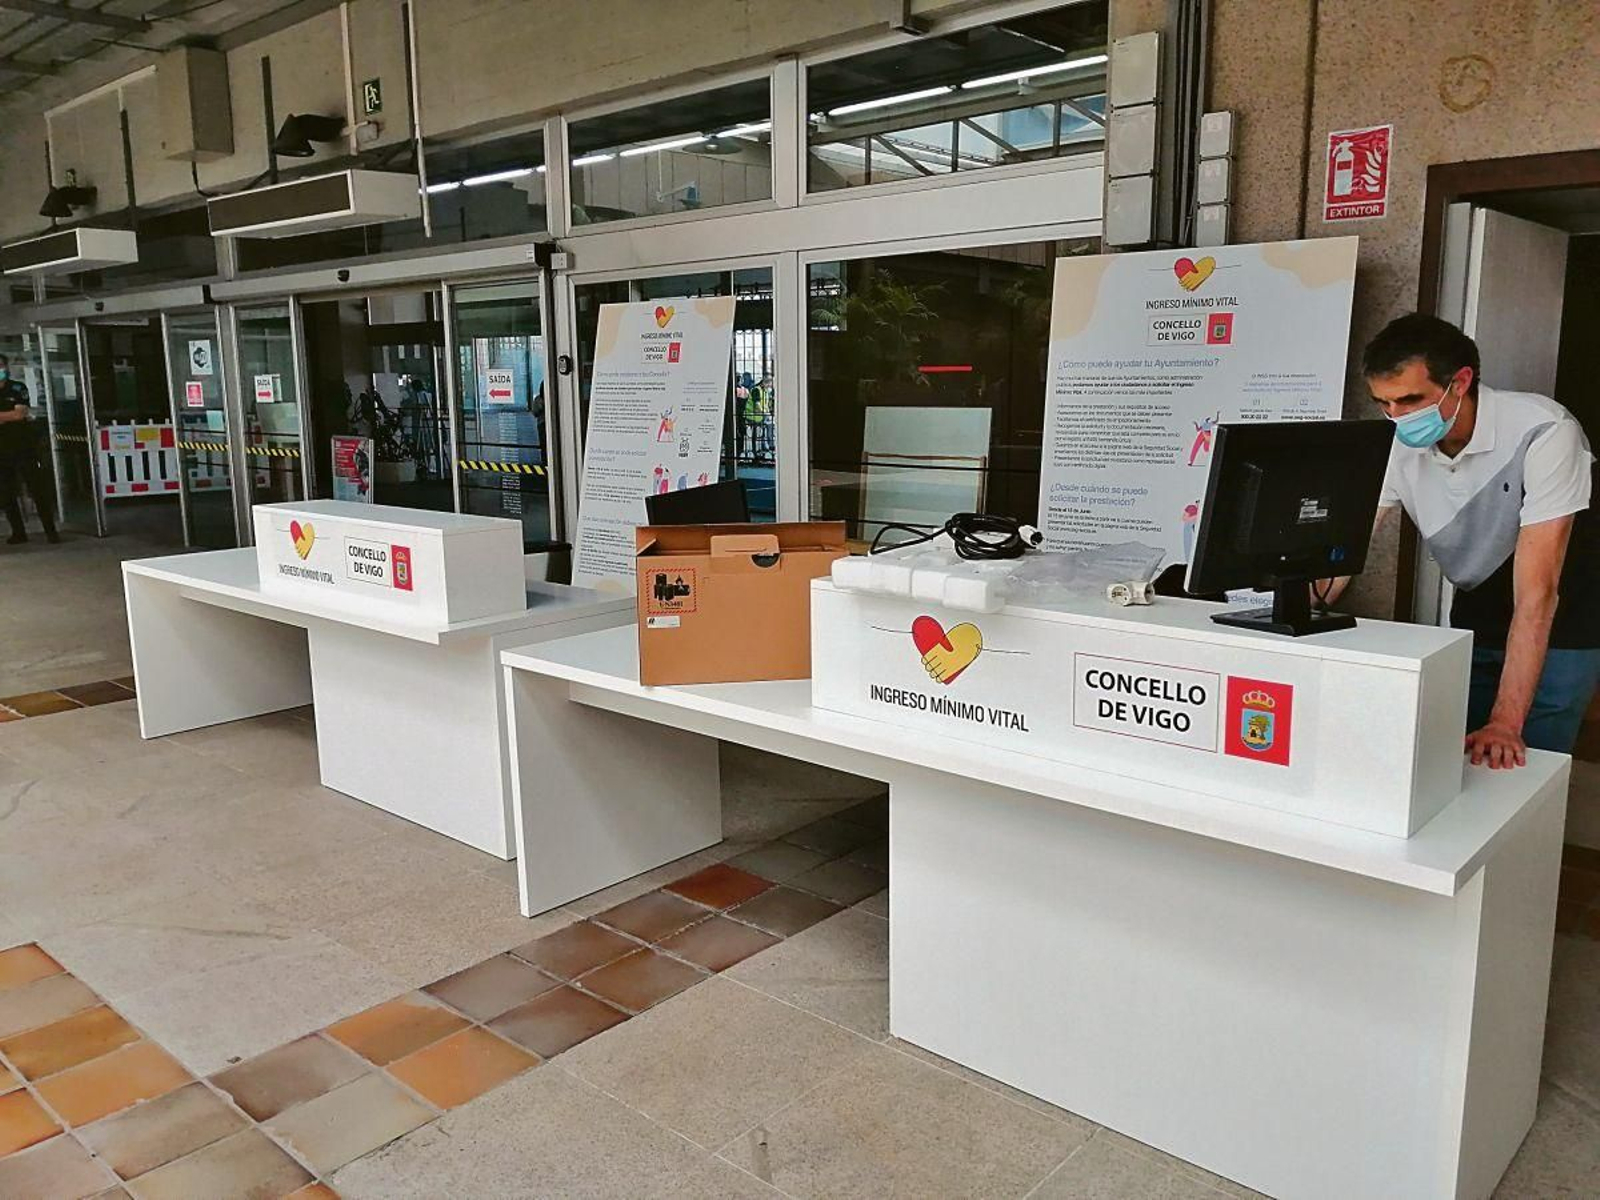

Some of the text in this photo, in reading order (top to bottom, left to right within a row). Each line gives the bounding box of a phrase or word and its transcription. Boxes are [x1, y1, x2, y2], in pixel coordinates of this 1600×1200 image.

[1330, 205, 1380, 217] EXTINTOR
[1145, 296, 1239, 309] INGRESO MÍNIMO VITAL
[1152, 319, 1202, 330] CONCELLO
[1157, 331, 1195, 341] DE VIGO
[1114, 359, 1142, 370] ayudar
[1144, 359, 1152, 367] tu
[1155, 358, 1219, 369] Ayuntamiento?
[489, 373, 511, 383] SAÍDA
[1122, 487, 1149, 496] puede
[348, 545, 386, 562] CONCELLO
[354, 562, 383, 578] DE VIGO
[1085, 669, 1206, 705] CONCELLO
[870, 684, 1029, 733] INGRESO MÍNIMO VITAL
[1098, 699, 1191, 732] DE VIGO
